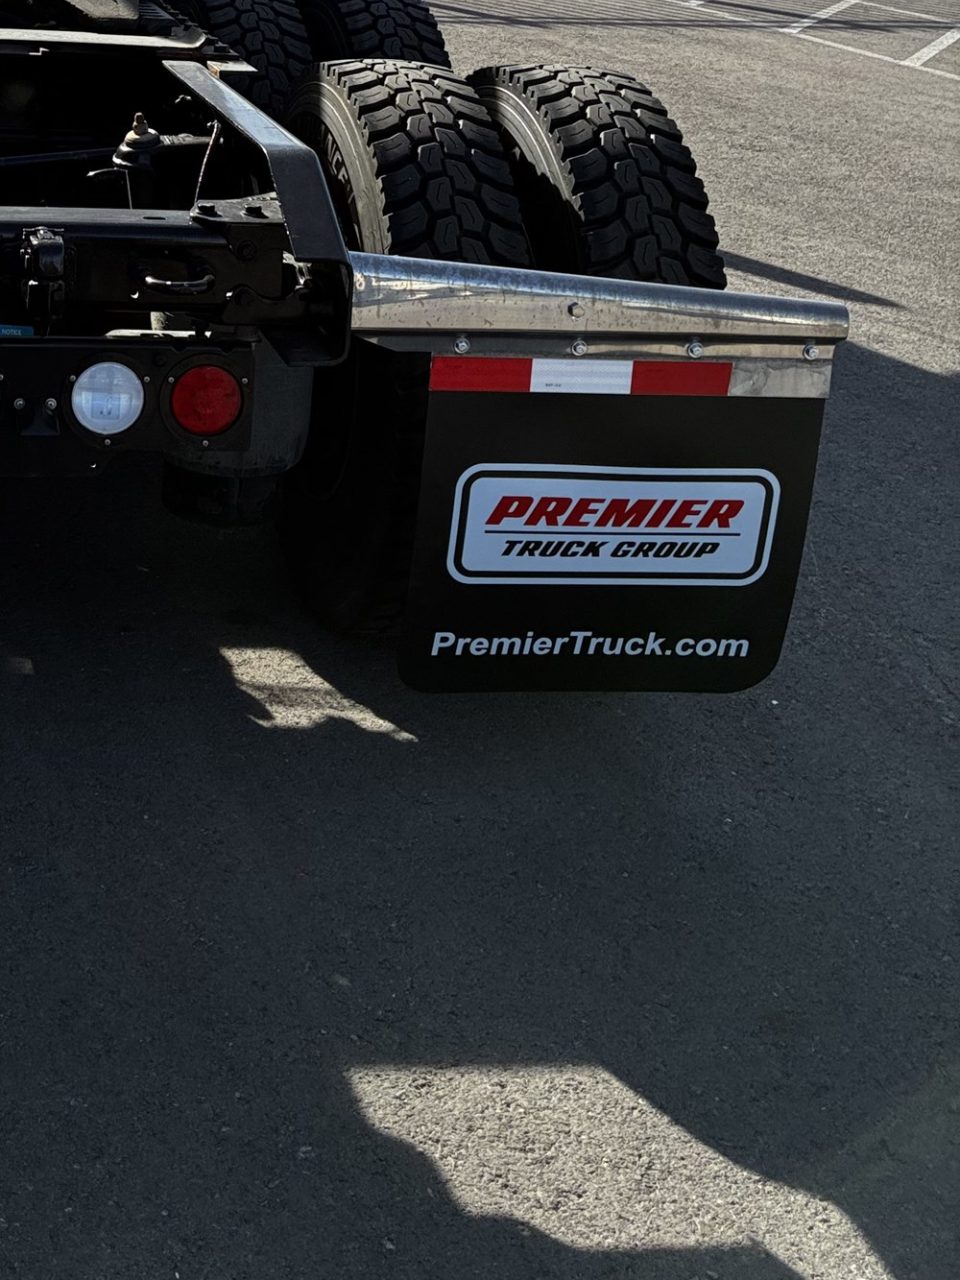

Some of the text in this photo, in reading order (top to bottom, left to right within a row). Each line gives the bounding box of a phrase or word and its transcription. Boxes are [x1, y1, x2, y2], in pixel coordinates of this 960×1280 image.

[484, 495, 745, 529] PREMIER
[501, 539, 720, 558] TRUCK GROUP
[431, 631, 749, 657] PremierTruck.com
